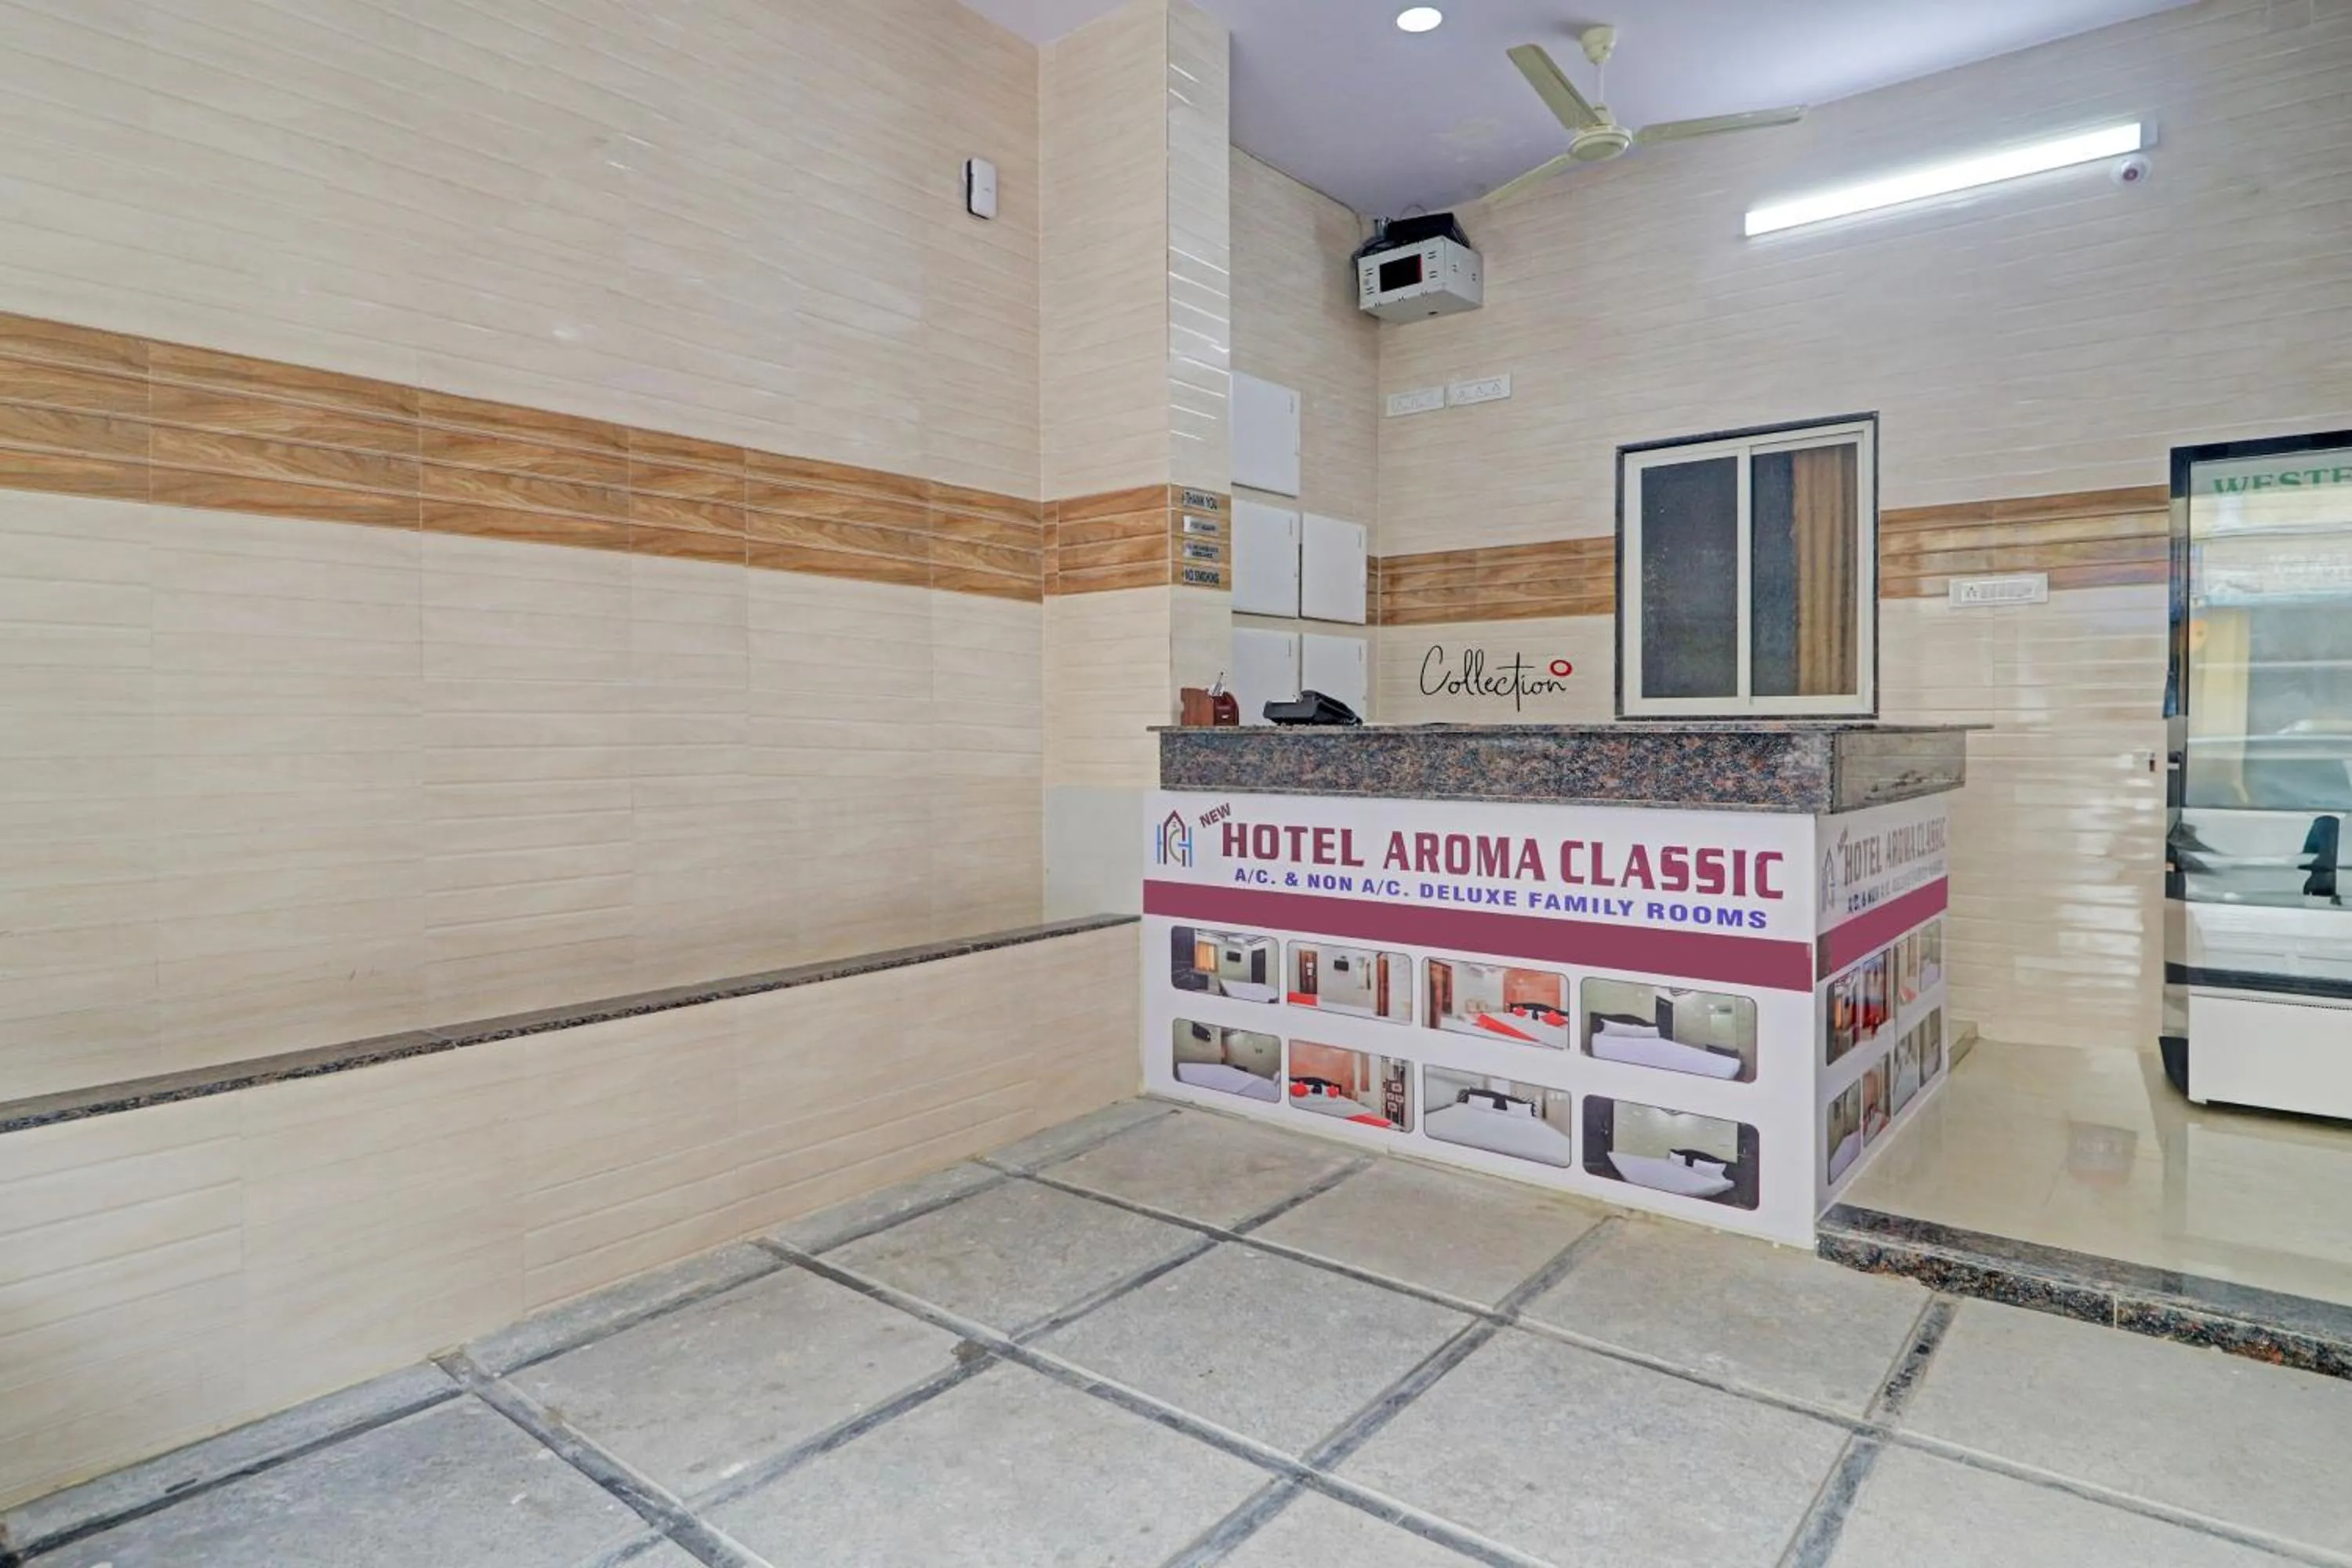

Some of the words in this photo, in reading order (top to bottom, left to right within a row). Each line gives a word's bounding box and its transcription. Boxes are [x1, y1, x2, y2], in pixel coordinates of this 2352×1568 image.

[1420, 645, 1566, 712] Collection
[1199, 803, 1232, 828] NEW
[1221, 821, 1365, 867] HOTEL
[1382, 830, 1546, 881] AROMA
[1559, 840, 1784, 900] CLASSIC
[1843, 835, 1882, 887] HOTEL
[1234, 868, 1276, 885] A/C.
[1284, 870, 1298, 887] &
[1307, 874, 1352, 891] NON
[1361, 878, 1410, 897] A/C.
[1419, 883, 1517, 907] DELUXE
[1528, 891, 1635, 916] FAMILY
[1646, 902, 1767, 929] ROOMS
